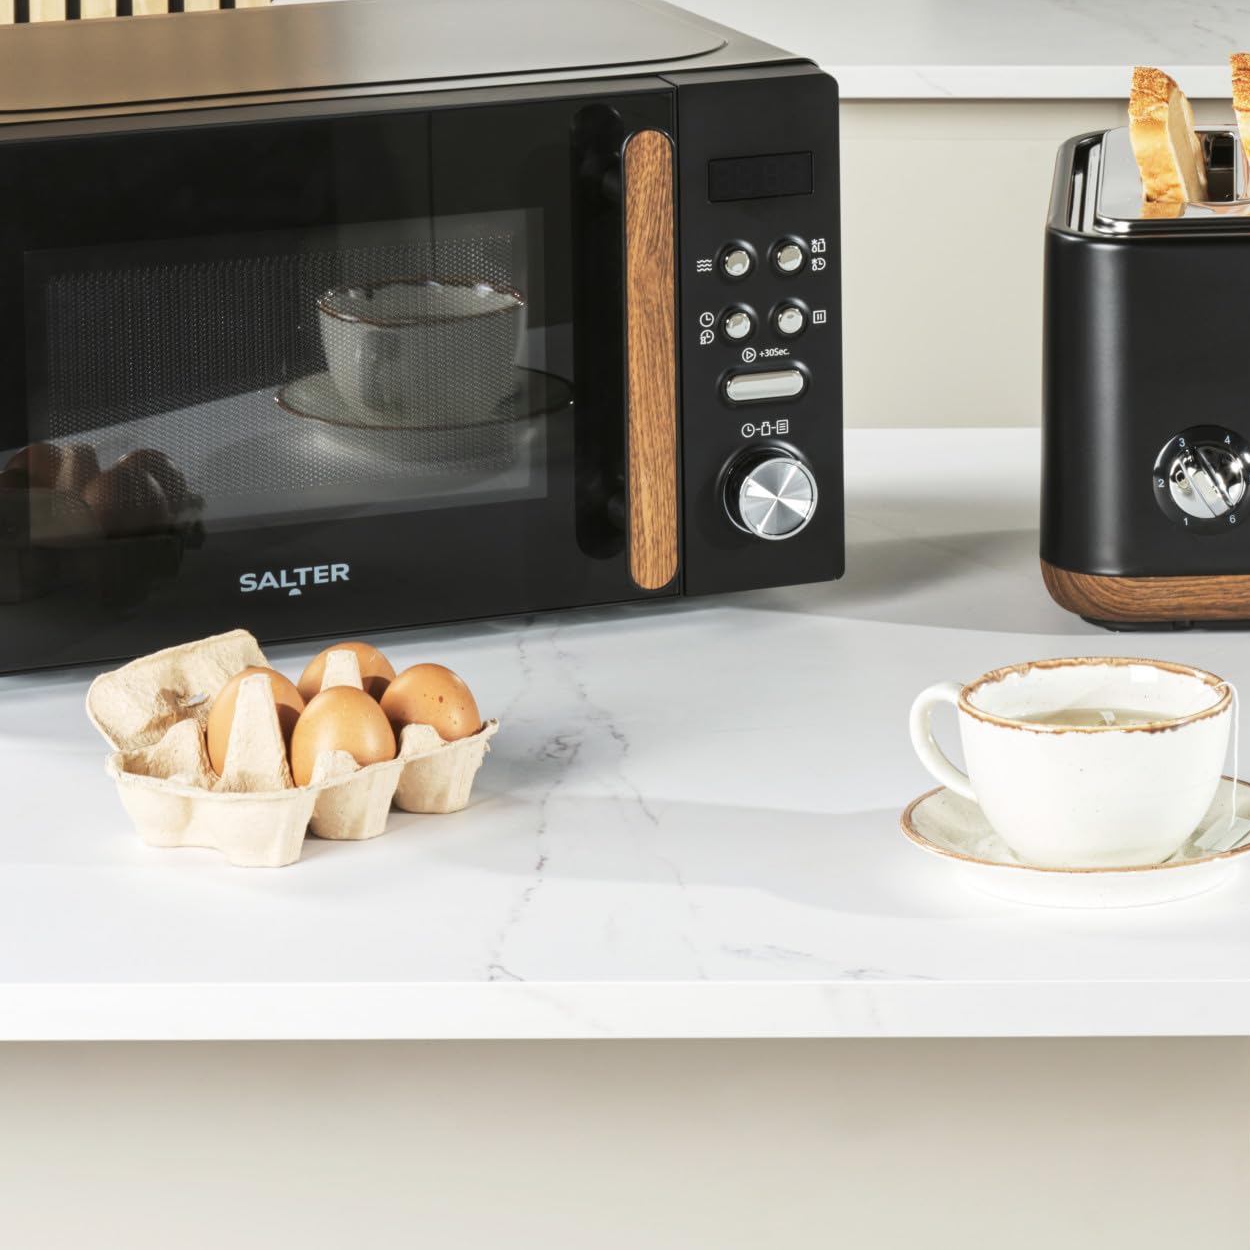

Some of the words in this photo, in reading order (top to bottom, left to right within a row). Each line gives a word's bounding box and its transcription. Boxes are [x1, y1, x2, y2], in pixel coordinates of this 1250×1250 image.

[1178, 437, 1186, 448] 3
[1224, 435, 1231, 445] 4
[1158, 478, 1165, 488] 2
[1183, 517, 1188, 526] 1
[1229, 514, 1236, 524] 6
[239, 563, 350, 593] SALTER
